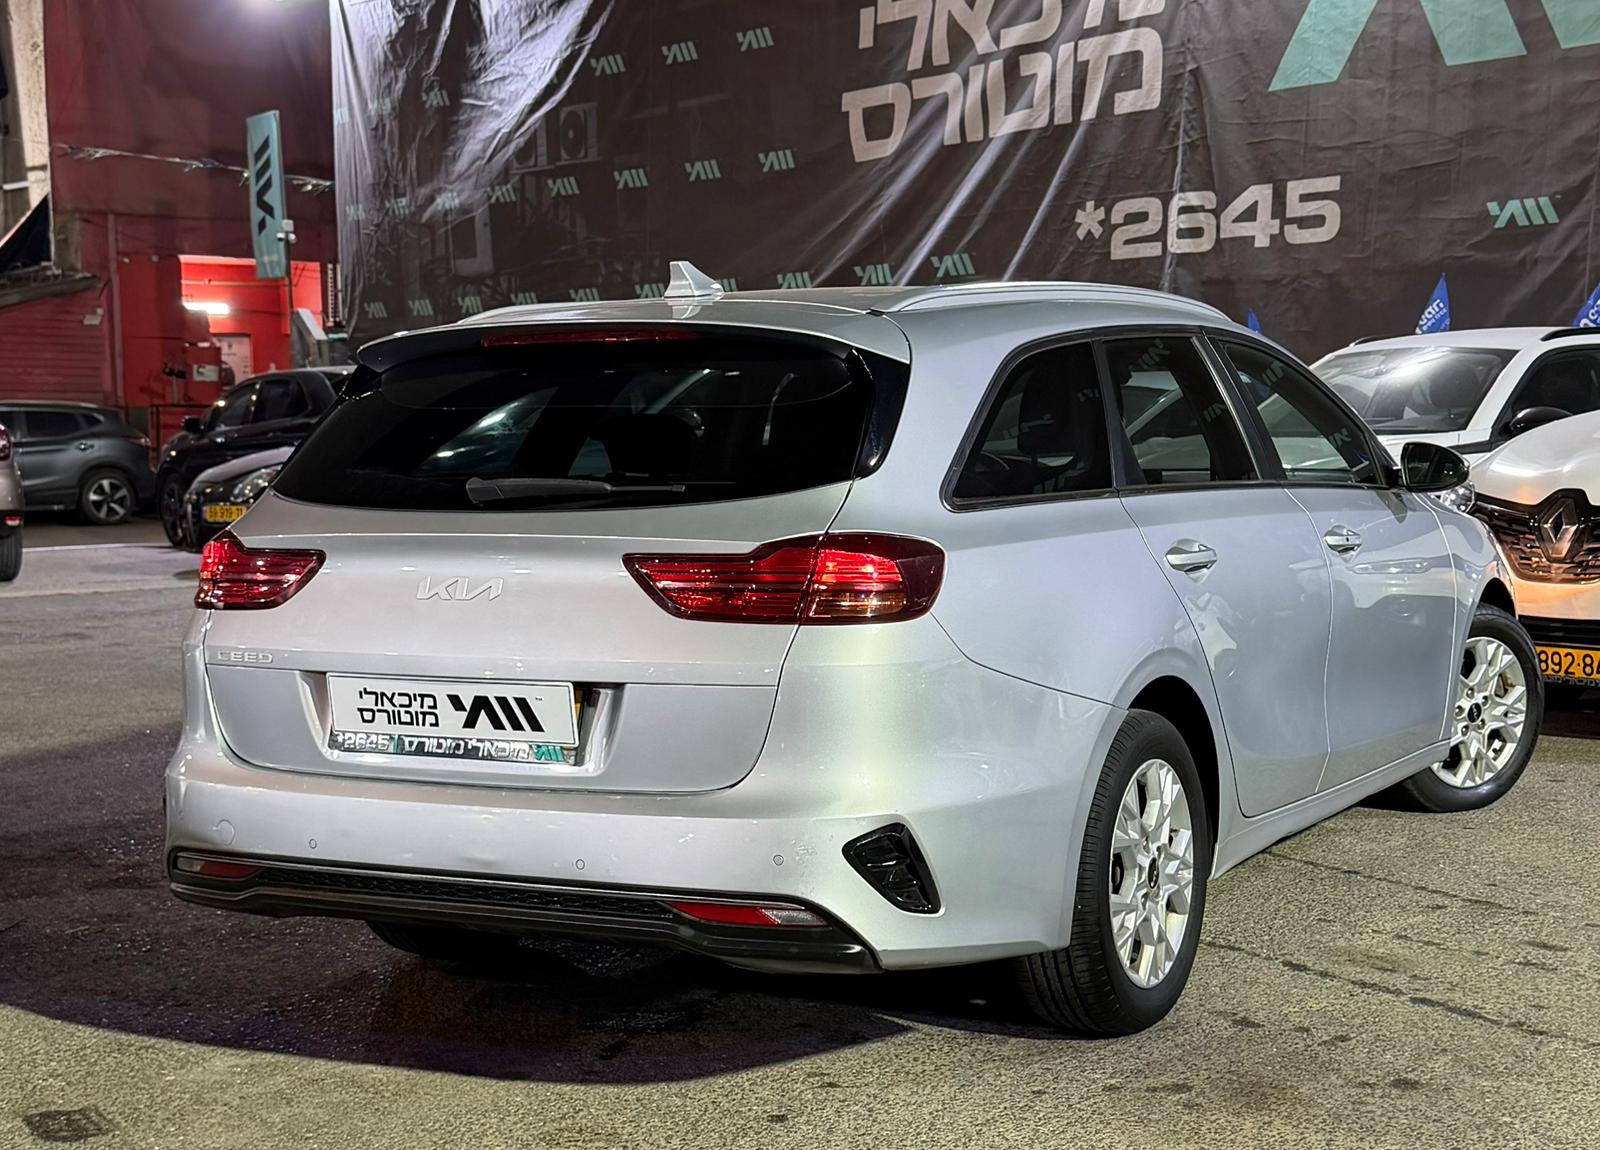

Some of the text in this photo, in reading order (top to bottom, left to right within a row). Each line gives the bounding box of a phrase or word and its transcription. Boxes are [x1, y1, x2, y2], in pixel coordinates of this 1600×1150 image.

[841, 27, 1163, 163] מוטורס
[416, 576, 504, 601] KIA
[217, 650, 273, 663] CEED
[359, 687, 438, 710] מיכאלי
[357, 707, 440, 728] מוטורס
[401, 735, 465, 755] מוטורס
[465, 738, 530, 759] מיכאלי
